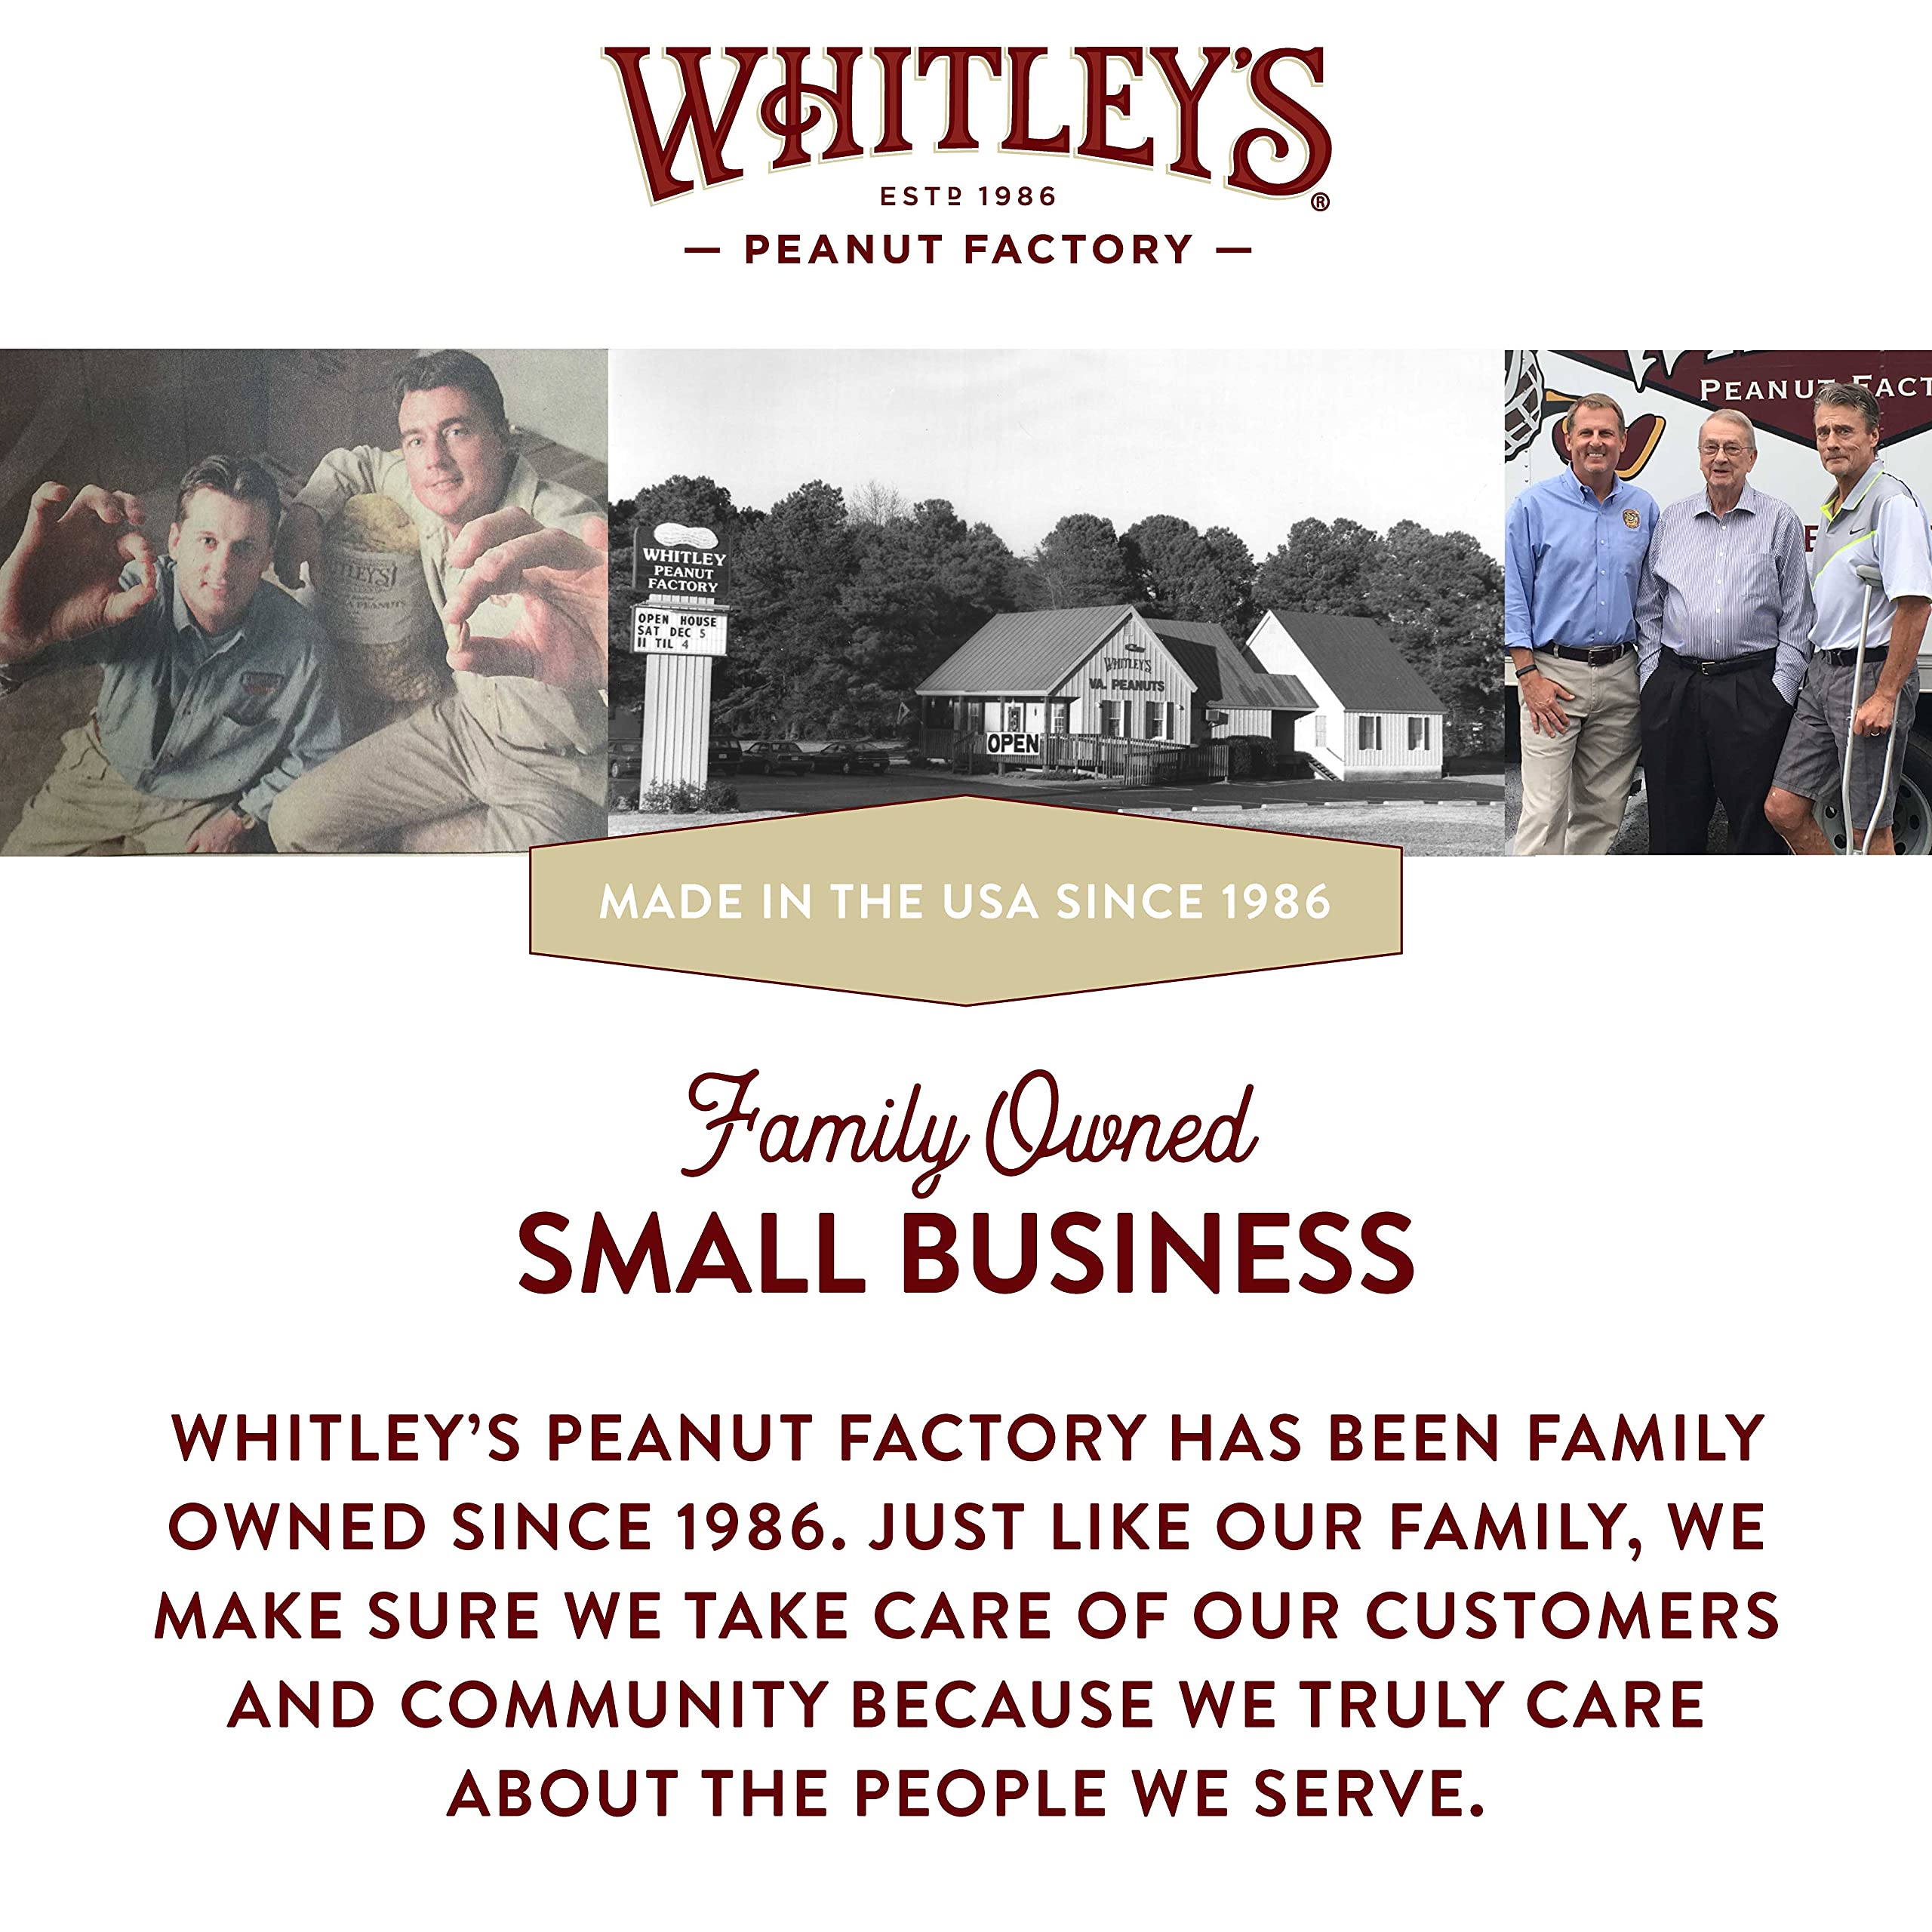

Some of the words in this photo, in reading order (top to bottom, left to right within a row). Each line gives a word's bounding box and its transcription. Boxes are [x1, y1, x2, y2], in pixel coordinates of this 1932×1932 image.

[642, 547, 727, 566] WHITLEY
[654, 565, 714, 580] PEANUT
[648, 578, 718, 592] FACTORY
[638, 614, 669, 625] OPEN
[680, 616, 717, 627] HOUSE
[637, 626, 660, 635] SAT
[670, 627, 691, 638] DEC
[700, 629, 706, 638] 5
[655, 638, 674, 649] TIL
[681, 640, 689, 650] 4
[1088, 678, 1107, 690] VA.
[1111, 678, 1165, 692] PEANUTS
[987, 733, 1040, 754] OPEN
